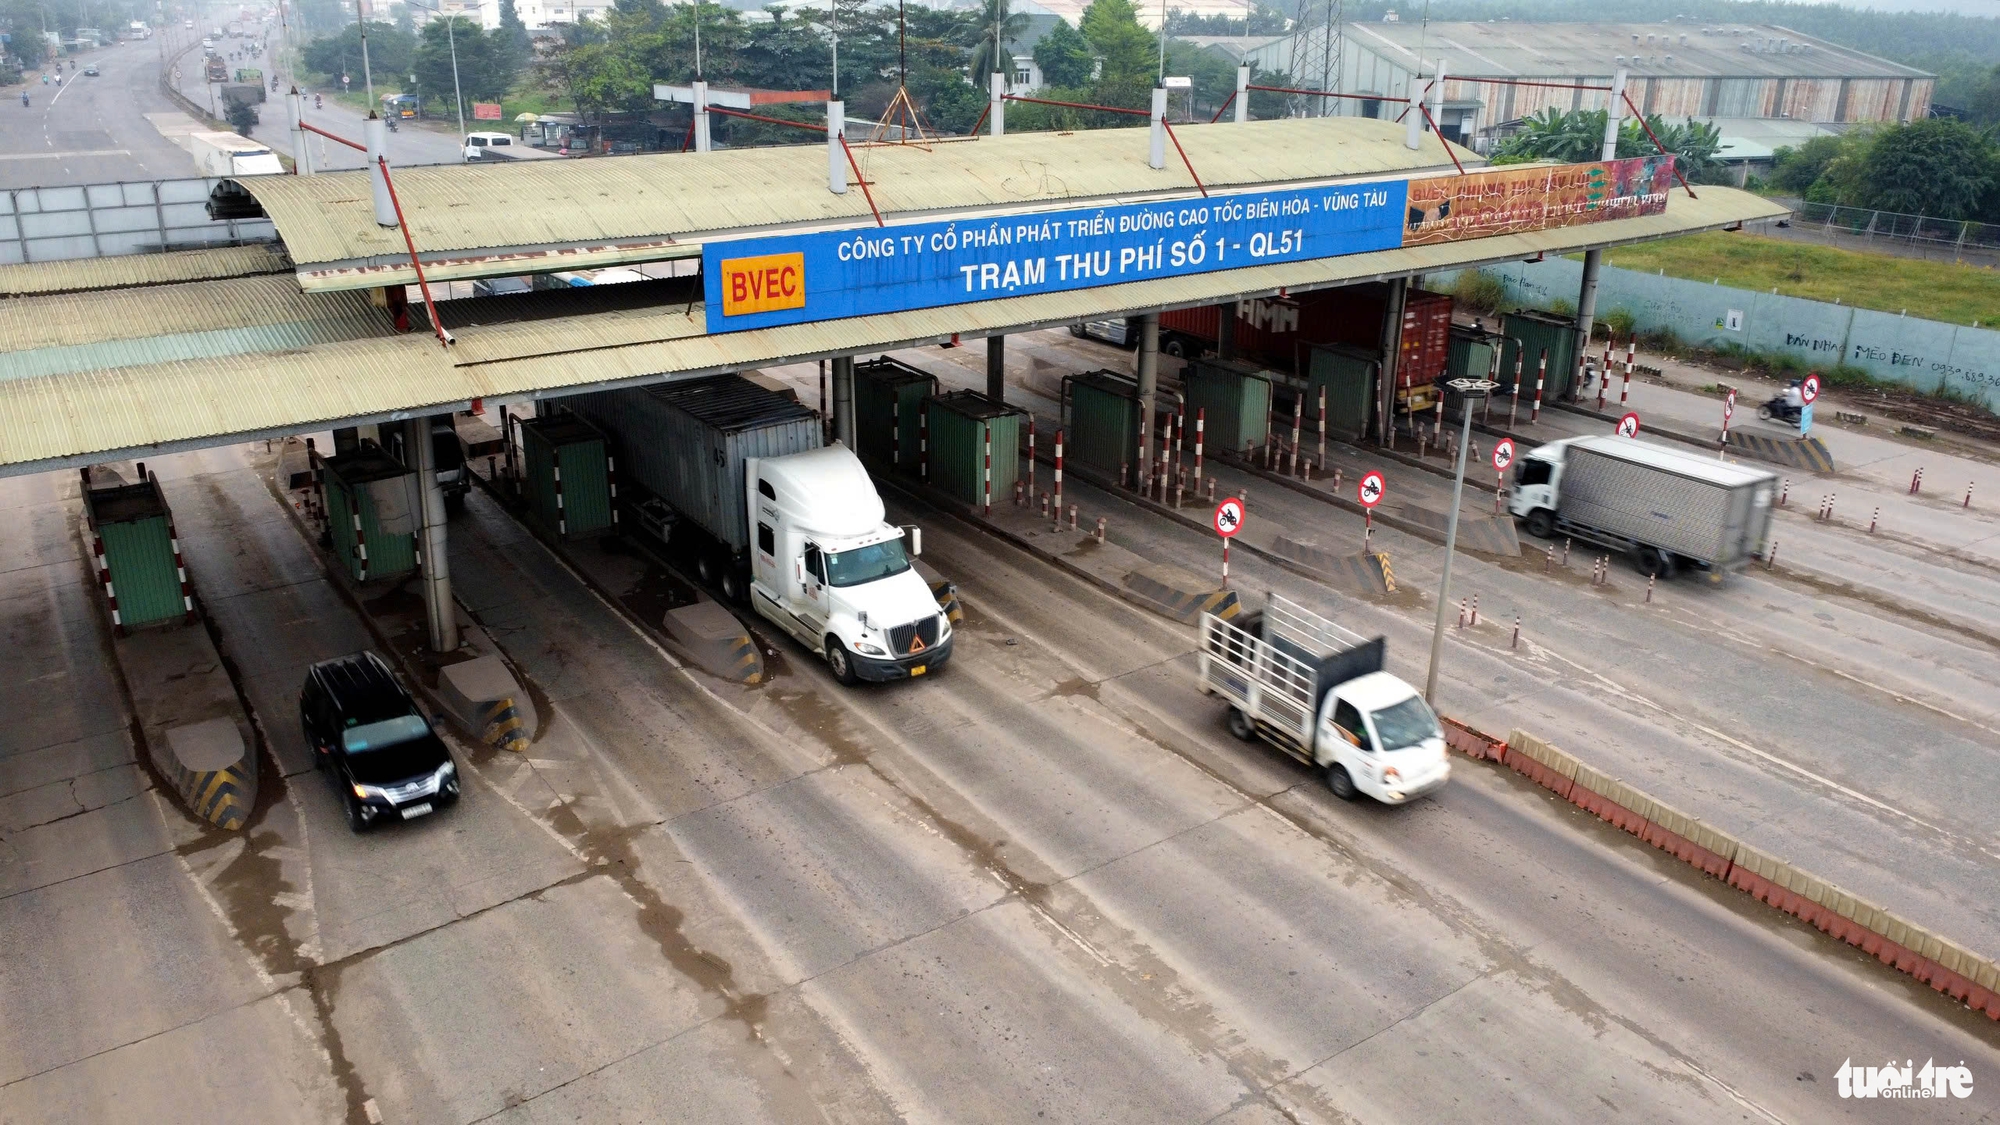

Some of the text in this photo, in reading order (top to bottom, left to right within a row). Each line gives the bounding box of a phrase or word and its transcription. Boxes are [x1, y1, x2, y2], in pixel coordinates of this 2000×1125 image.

[838, 236, 895, 262] CÔNG
[901, 235, 925, 254] TY
[930, 223, 957, 251] CỔ
[963, 221, 1012, 249] PHẦN
[1017, 219, 1063, 243] PHÁT
[1067, 209, 1115, 238] TRIỂN
[1120, 209, 1175, 233] ĐƯỜNG
[1179, 207, 1209, 227] CAO
[1214, 200, 1243, 223] TỐC
[1246, 198, 1279, 220] BIÊN
[1282, 196, 1310, 216] HÒA
[1323, 192, 1358, 212] VŨNG
[1362, 190, 1391, 208] TÀU
[731, 266, 797, 303] BVEC
[960, 257, 1046, 292] TRẠM
[1055, 249, 1111, 281] THU
[1119, 237, 1165, 274] PHÍ
[1171, 230, 1207, 267] SỐ
[1215, 237, 1225, 261] 1
[1249, 229, 1304, 258] QL51
[1236, 299, 1300, 334] HMM
